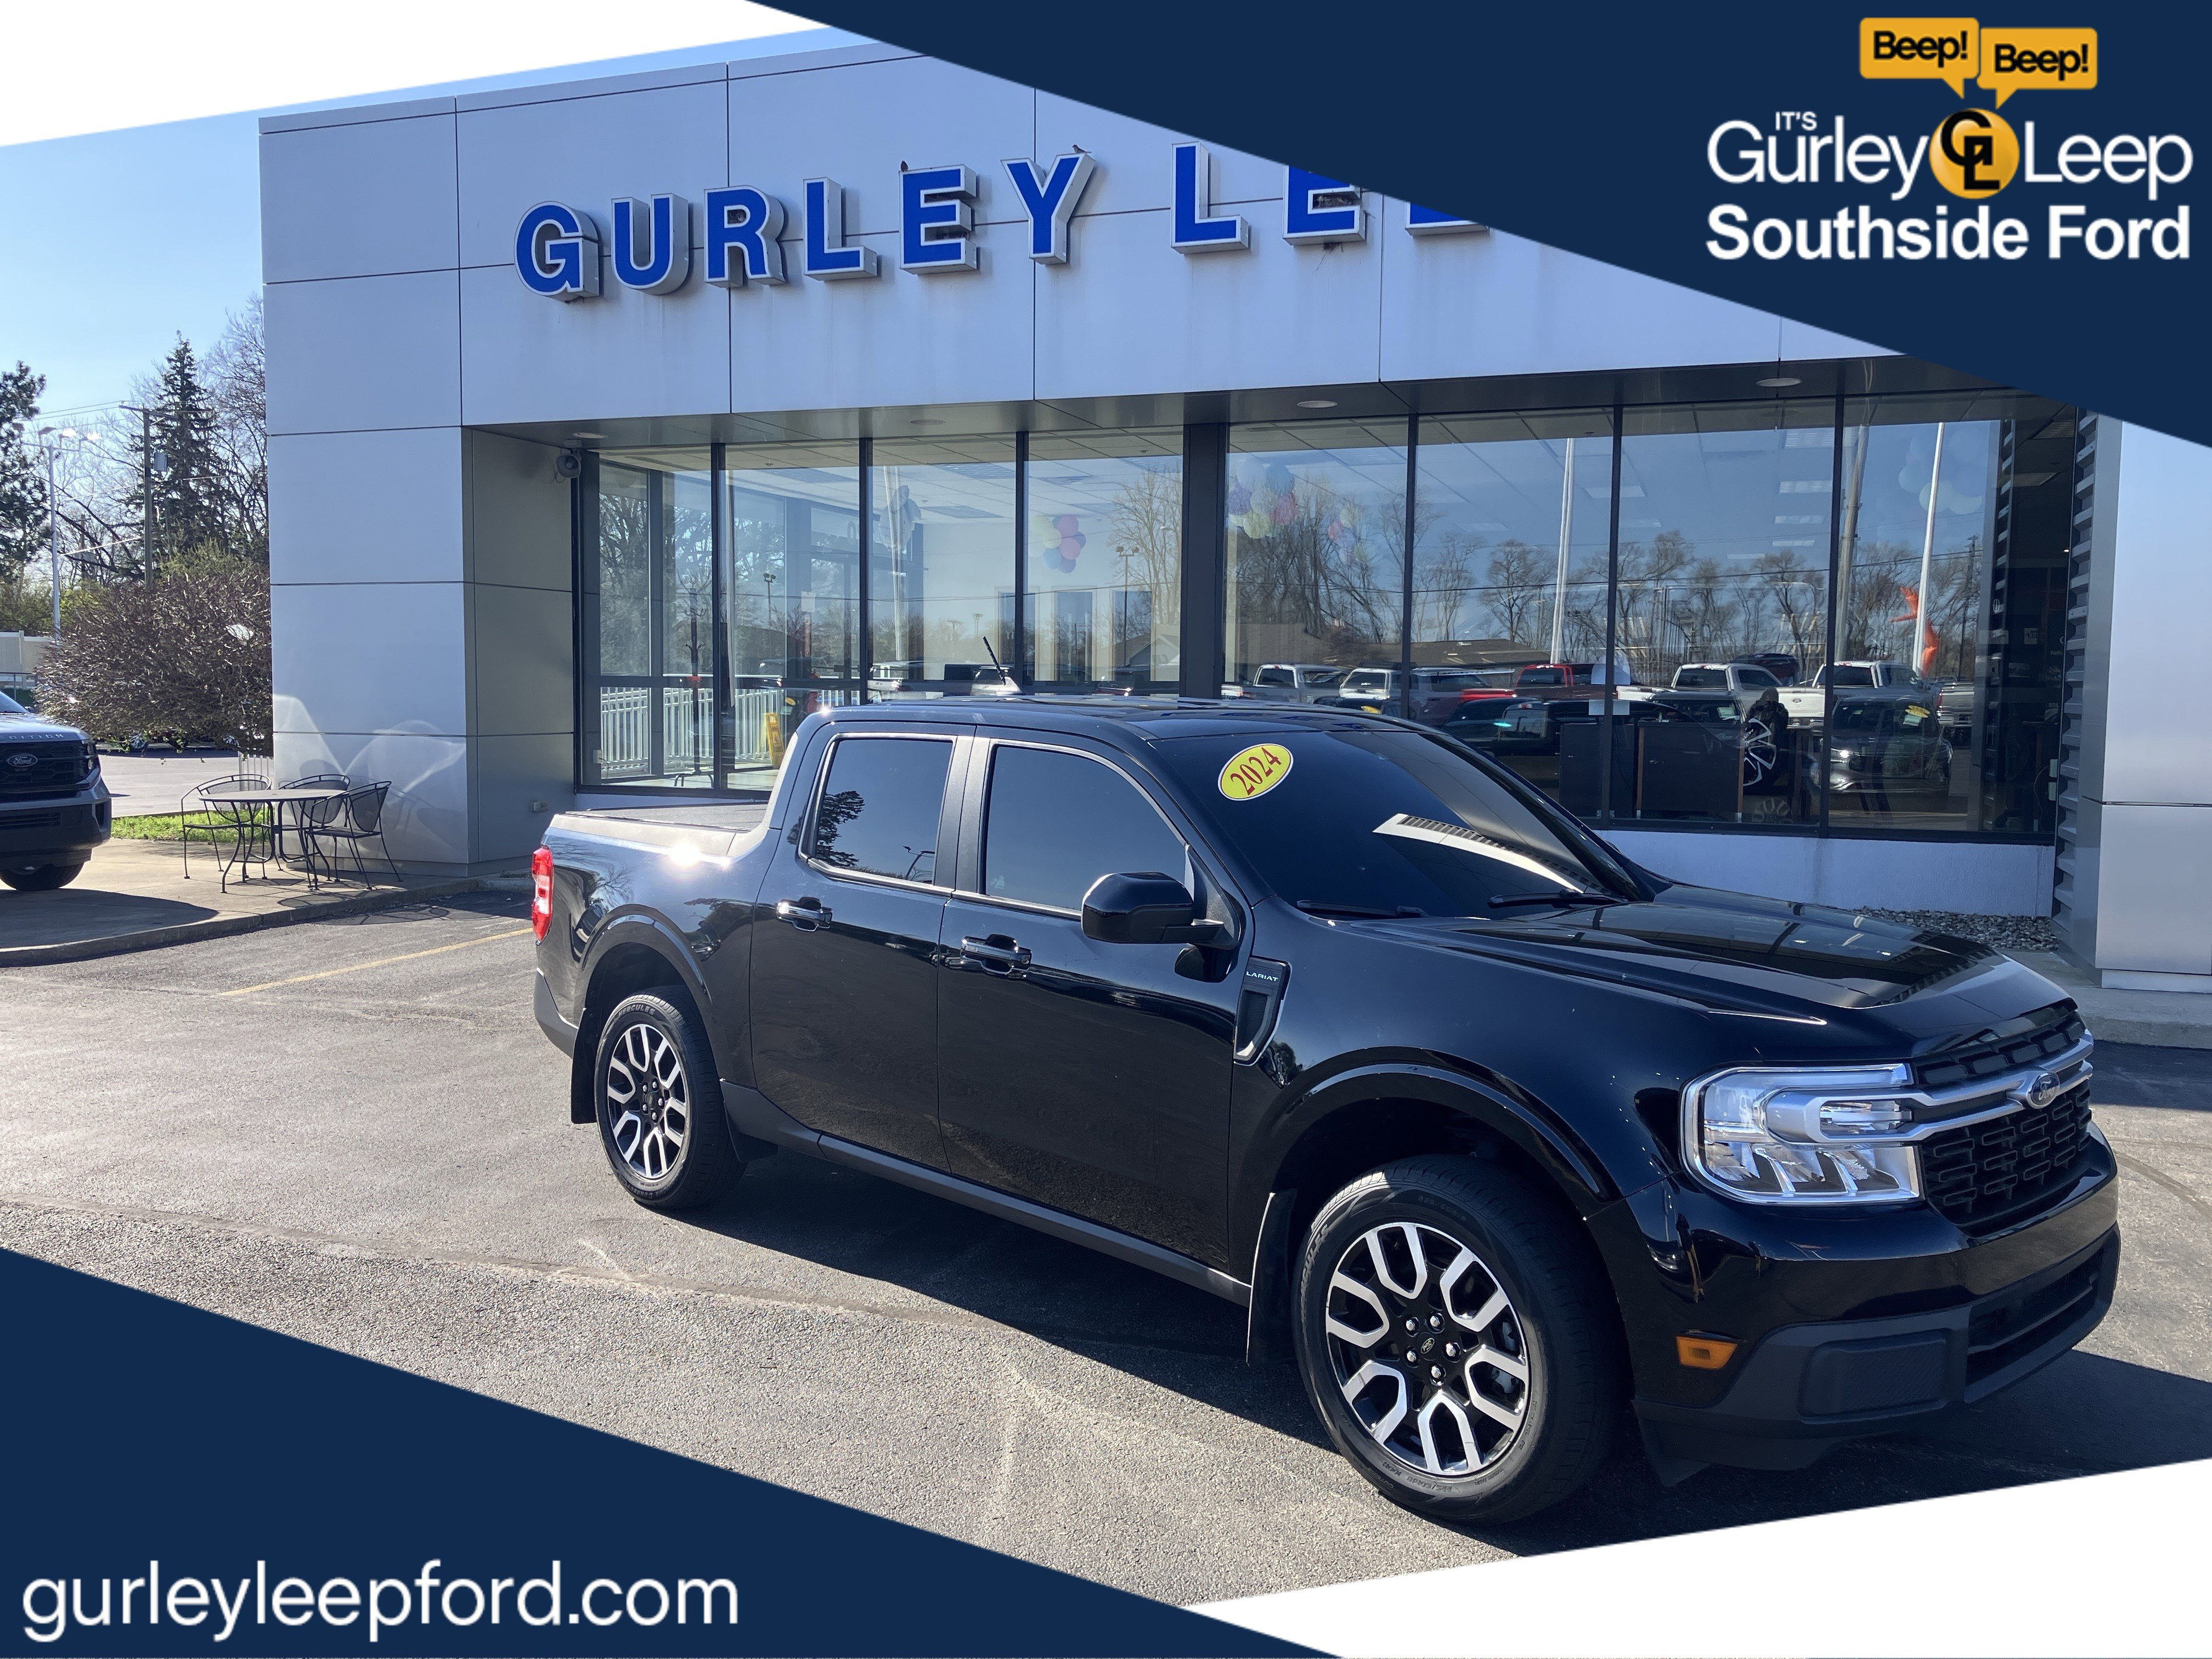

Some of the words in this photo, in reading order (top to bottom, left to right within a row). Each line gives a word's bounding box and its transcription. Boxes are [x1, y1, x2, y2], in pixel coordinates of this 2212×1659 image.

[514, 153, 1096, 301] GURLEY
[1170, 141, 1488, 254] LE
[13, 756, 32, 765] Ford
[1230, 747, 1282, 795] 2024
[1246, 971, 1279, 982] LARIAT
[618, 1004, 656, 1017] HERCULES
[2038, 1080, 2056, 1101] Ford
